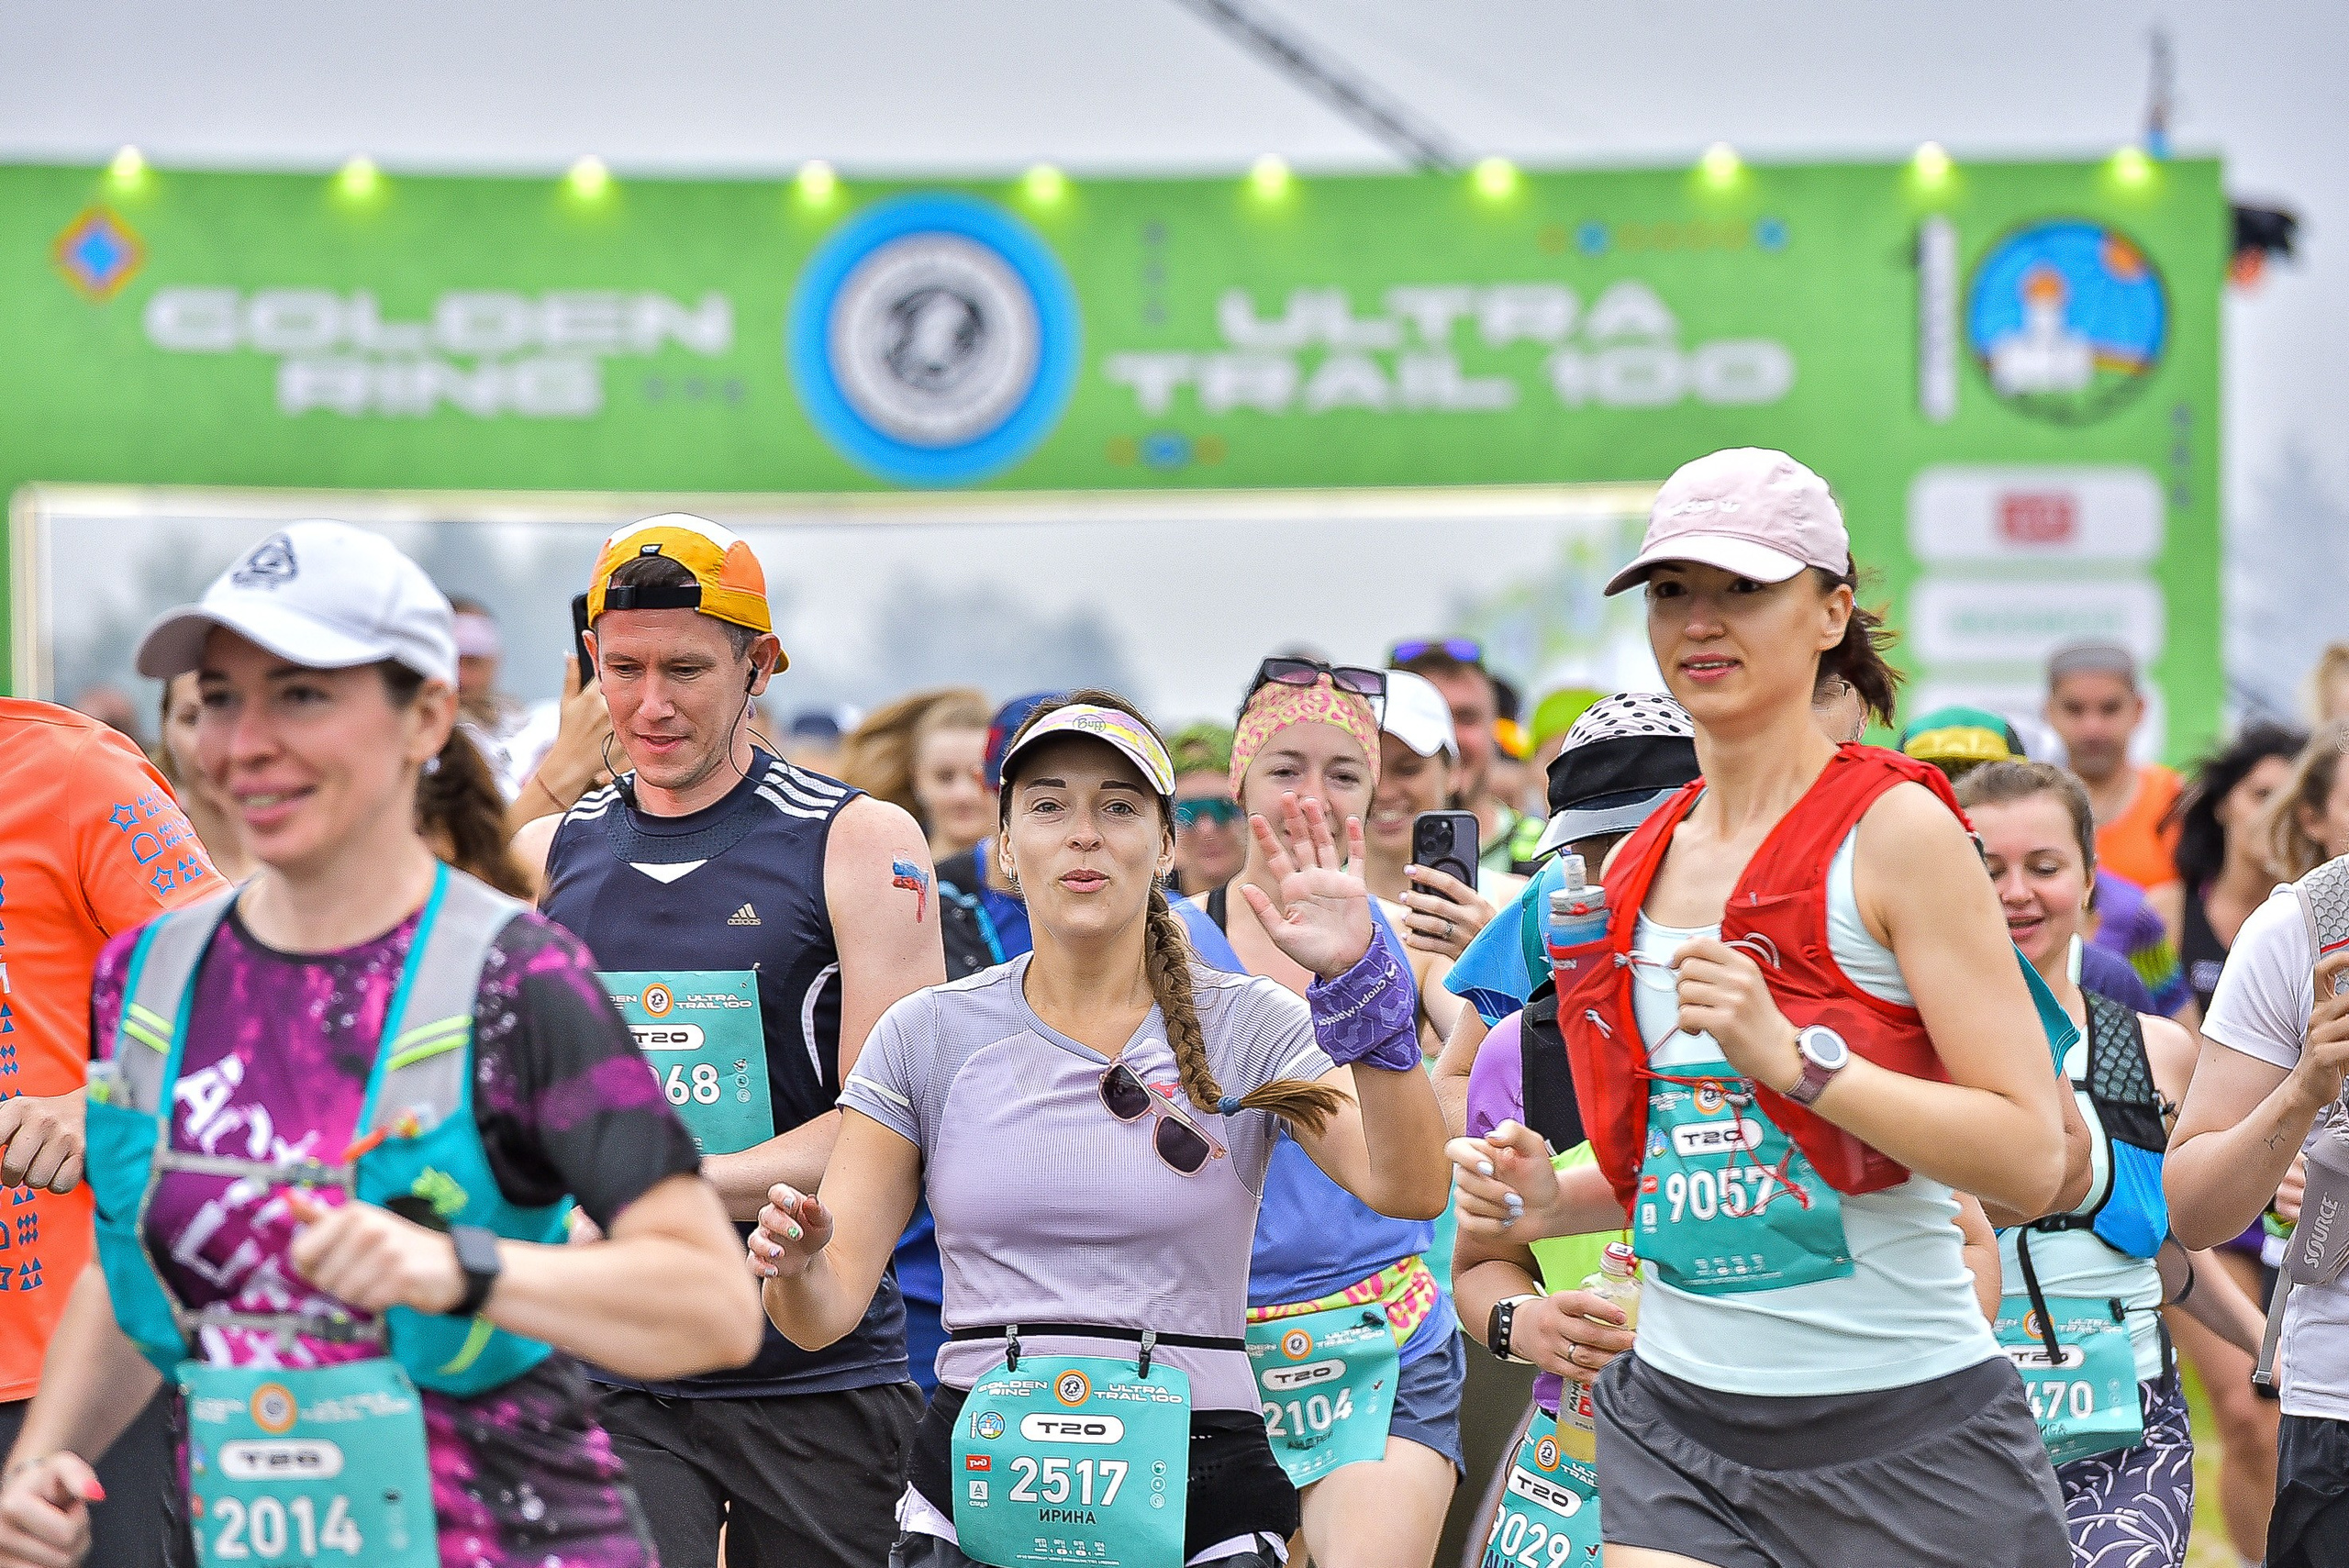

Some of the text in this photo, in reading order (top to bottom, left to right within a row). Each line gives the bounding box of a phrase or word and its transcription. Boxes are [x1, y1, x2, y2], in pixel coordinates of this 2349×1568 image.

[144, 286, 732, 355] GOLDEN
[1219, 281, 1677, 350] ULTRA
[1107, 339, 1795, 415] TRAIL 100
[675, 1000, 752, 1009] TRAIL 100
[687, 993, 739, 1002] ULTRA
[632, 1032, 688, 1042] T20
[648, 1062, 721, 1106] 68
[1665, 1164, 1778, 1224] 9057
[2303, 1192, 2339, 1269] SOURCE
[1108, 1383, 1168, 1395] ULTRA
[1274, 1367, 1331, 1384] T20
[1093, 1391, 1183, 1404] TRAIL 100
[1263, 1387, 1353, 1437] 2104
[2024, 1380, 2094, 1419] 470
[1037, 1421, 1107, 1435] T20
[1008, 1456, 1130, 1507] 2517
[1573, 1462, 1598, 1478] ULT
[1517, 1474, 1568, 1507] T20
[213, 1494, 363, 1560] 2014
[1039, 1508, 1097, 1525] ИРИНА
